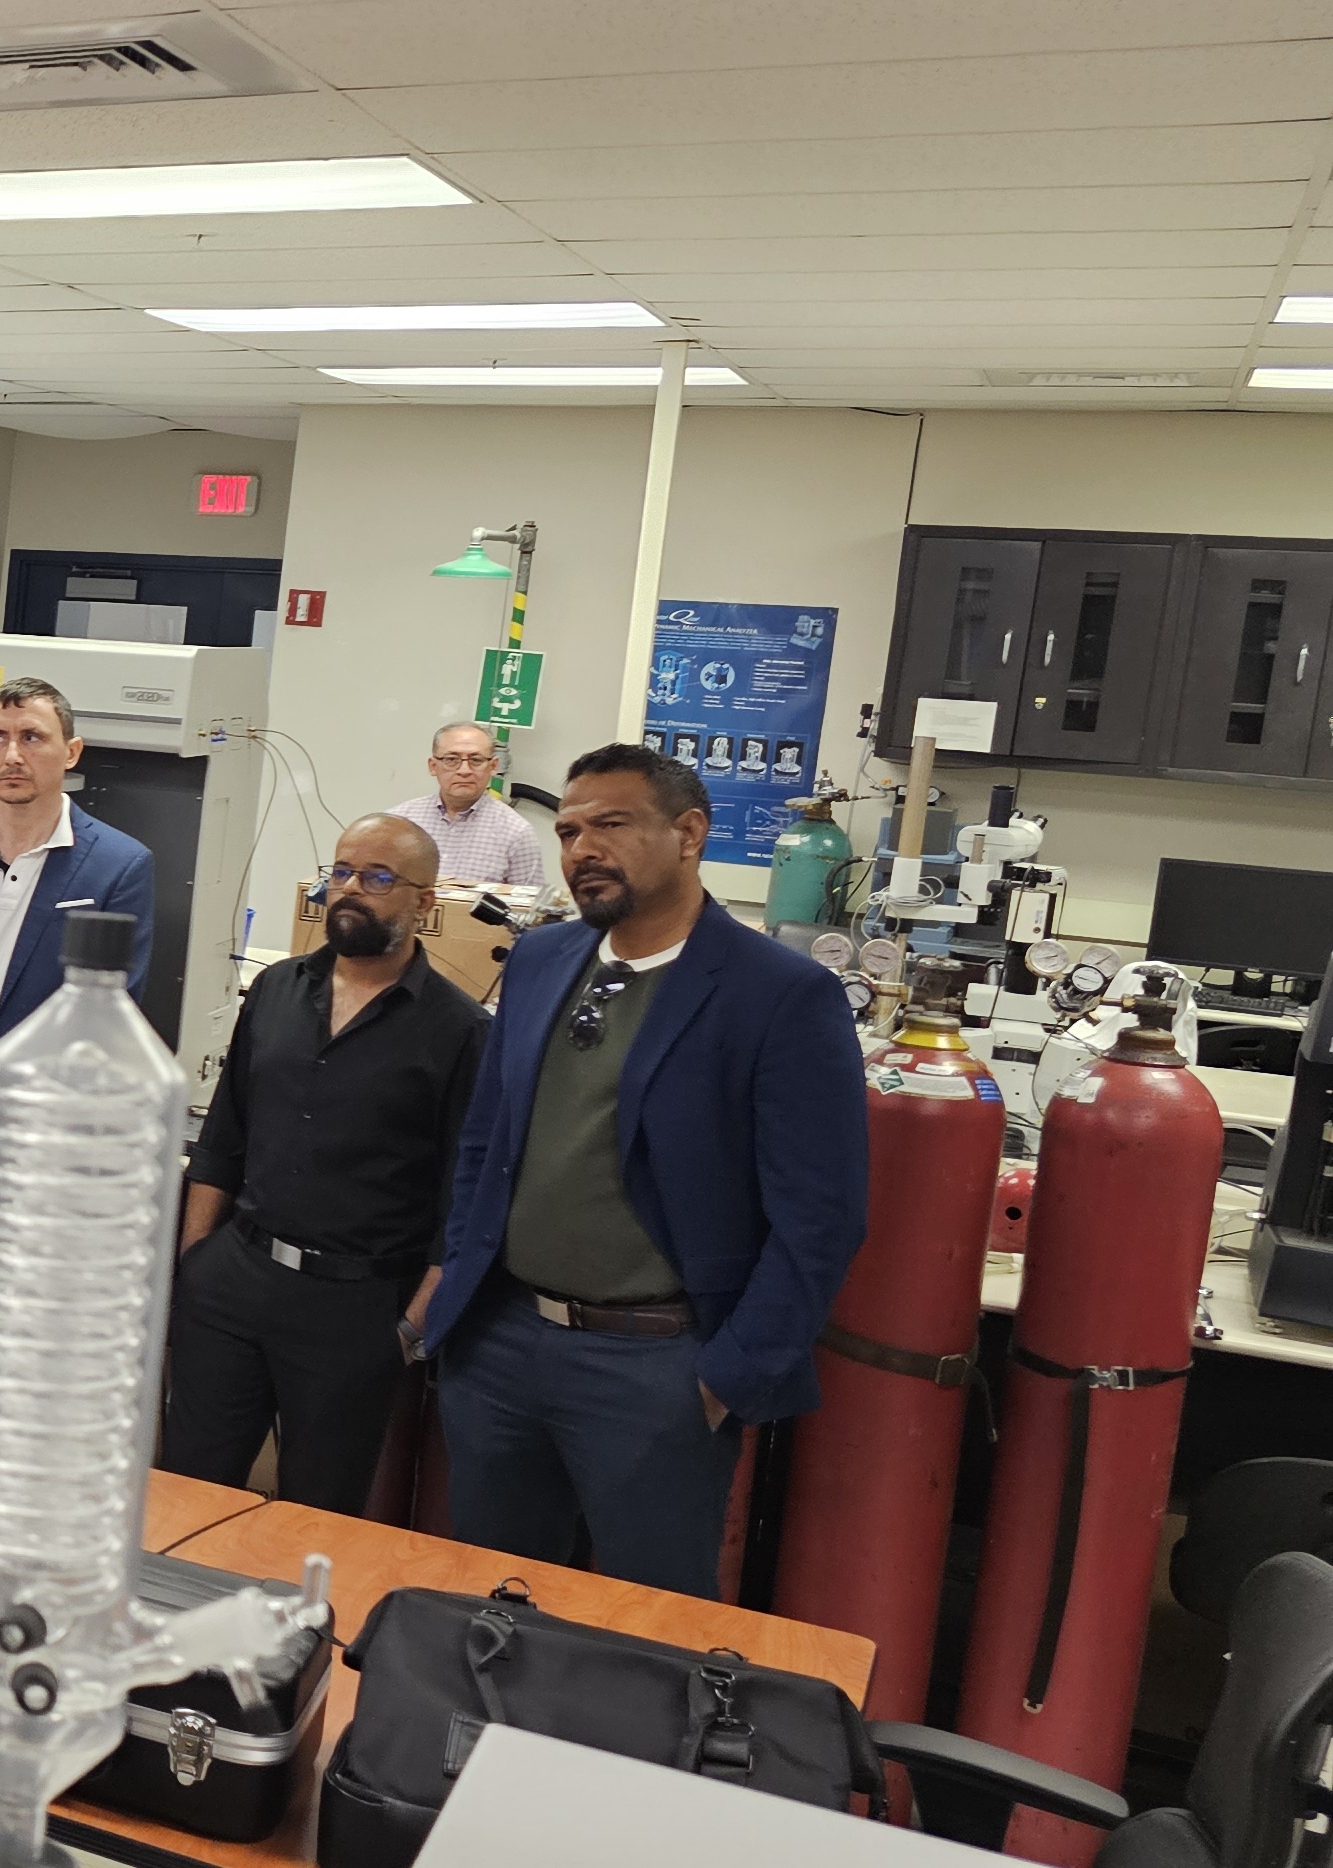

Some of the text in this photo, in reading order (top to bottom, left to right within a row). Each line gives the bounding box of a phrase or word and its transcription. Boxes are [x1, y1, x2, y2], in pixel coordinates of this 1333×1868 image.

[199, 475, 251, 513] EXIT
[668, 609, 700, 625] Q
[137, 690, 159, 702] 2020
